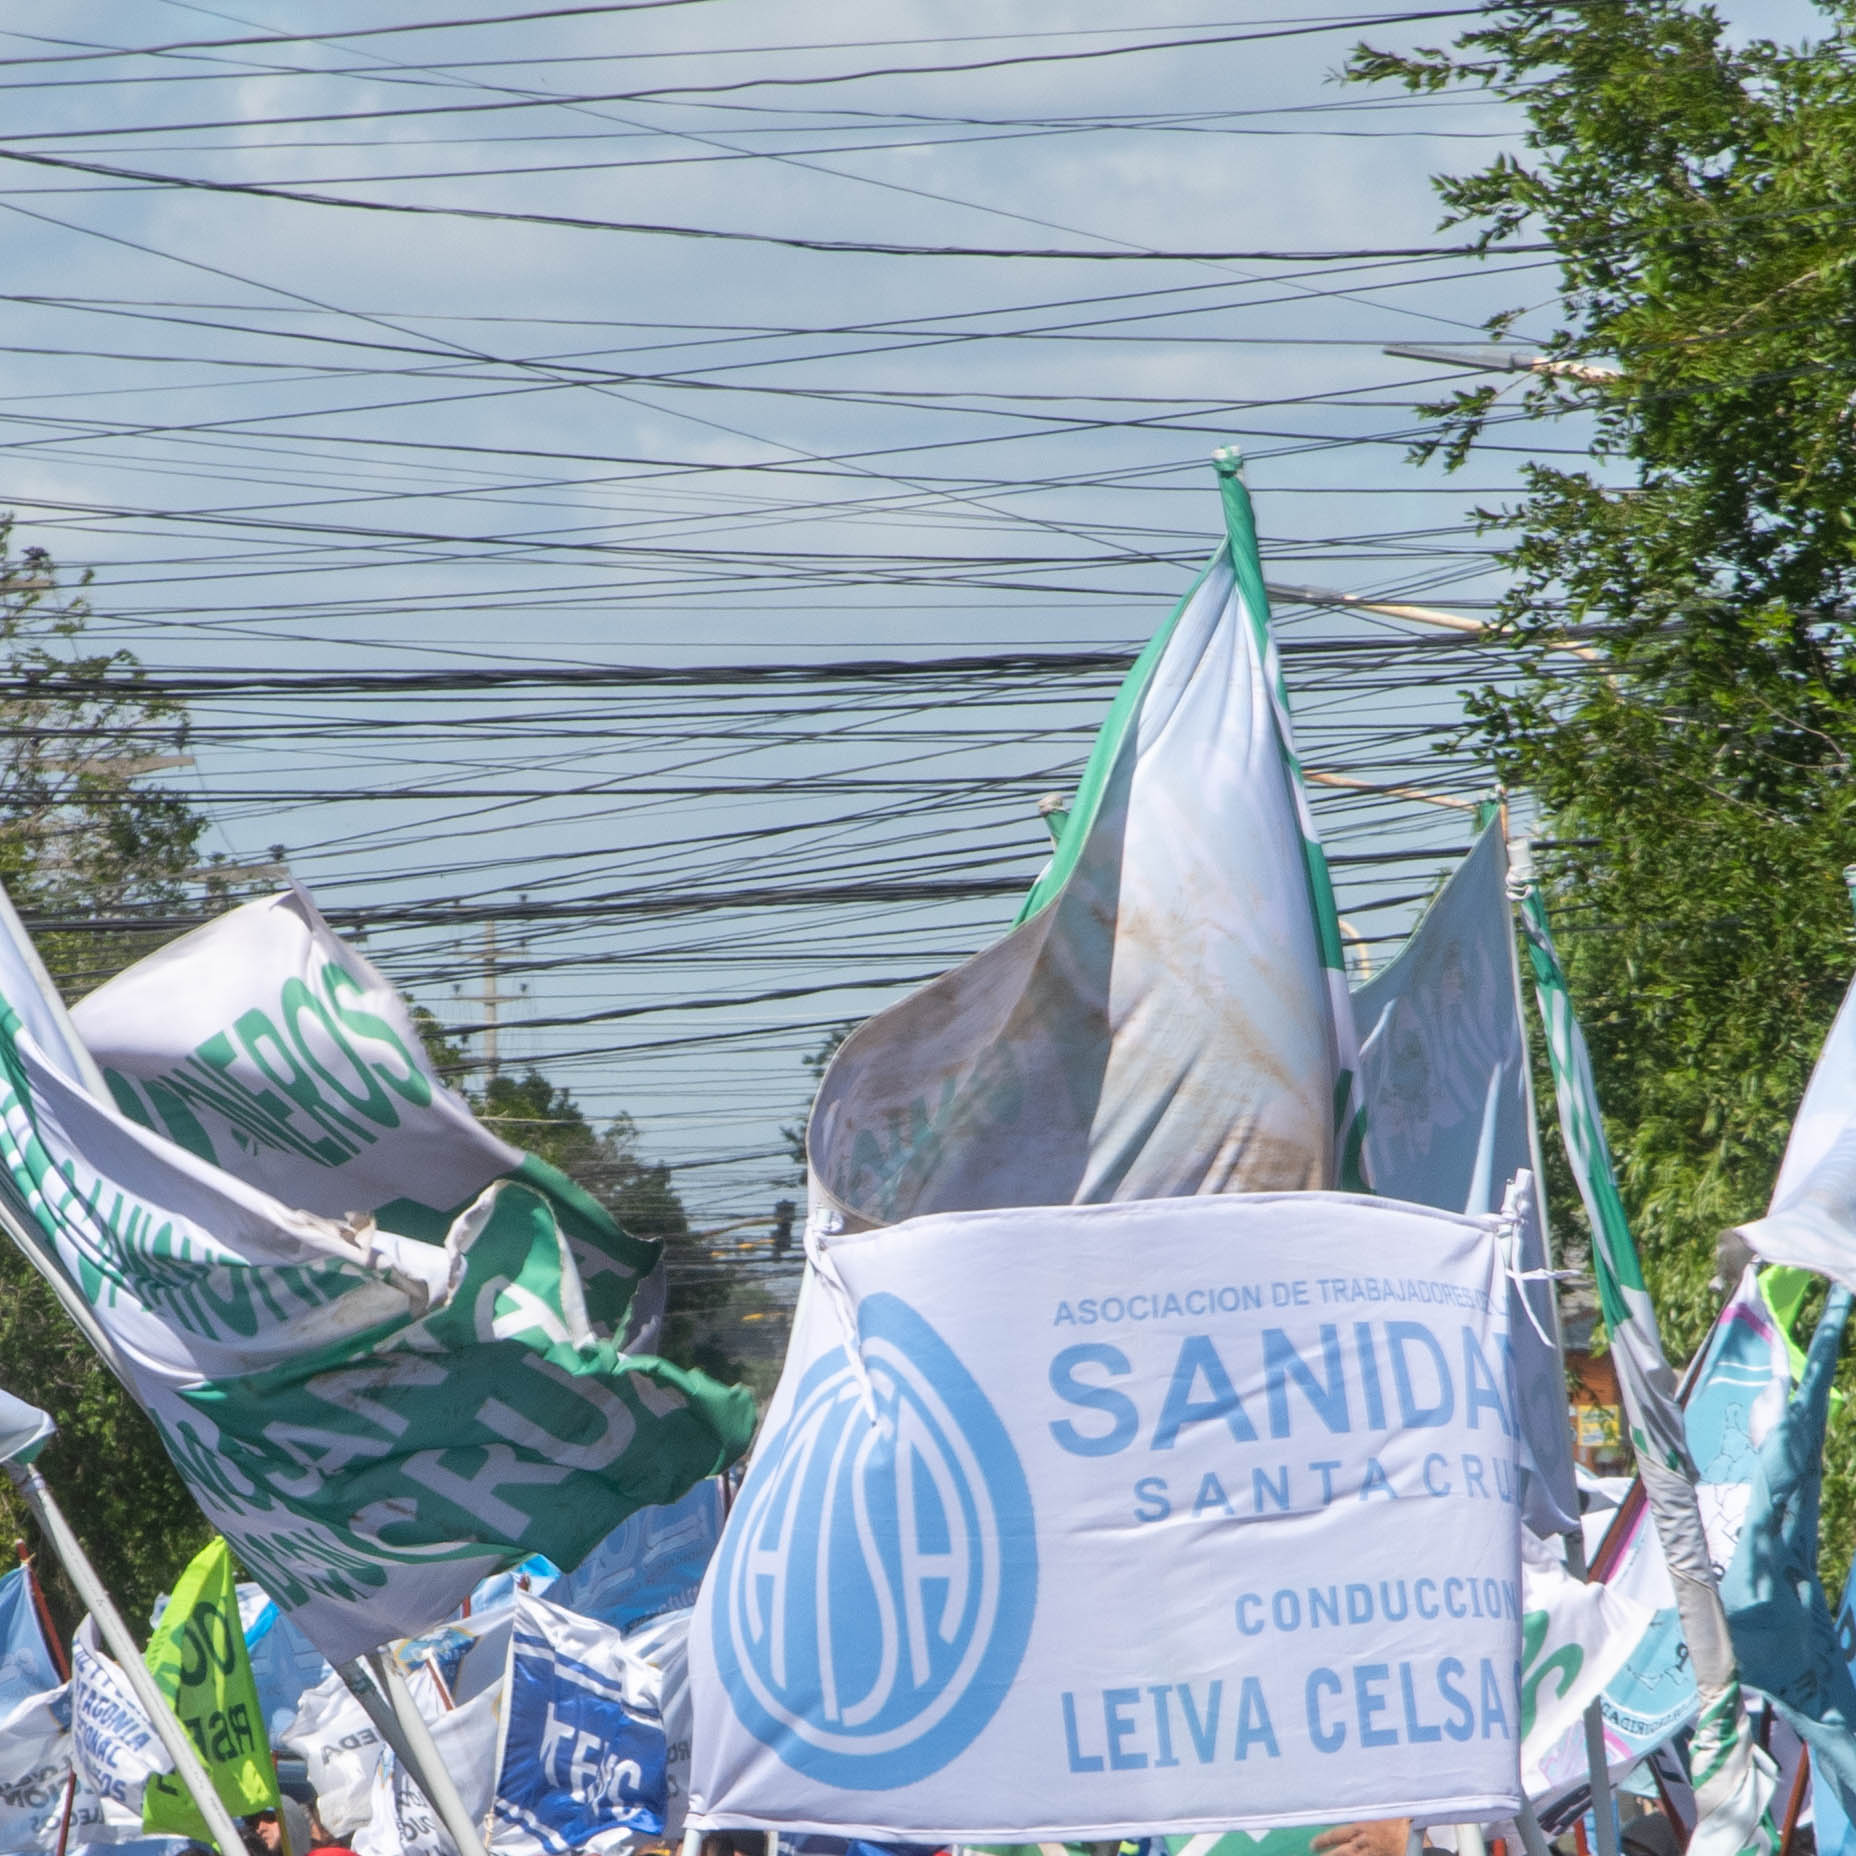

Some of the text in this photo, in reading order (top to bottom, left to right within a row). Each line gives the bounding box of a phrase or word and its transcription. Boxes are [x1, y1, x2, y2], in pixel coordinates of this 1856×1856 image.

[1053, 1283, 1262, 1327] ASOCIACION
[1271, 1280, 1310, 1307] DE
[1316, 1277, 1475, 1309] TRABAJADORES
[1133, 1451, 1515, 1522] SANTA CRU
[1061, 1675, 1282, 1774] LEIVA
